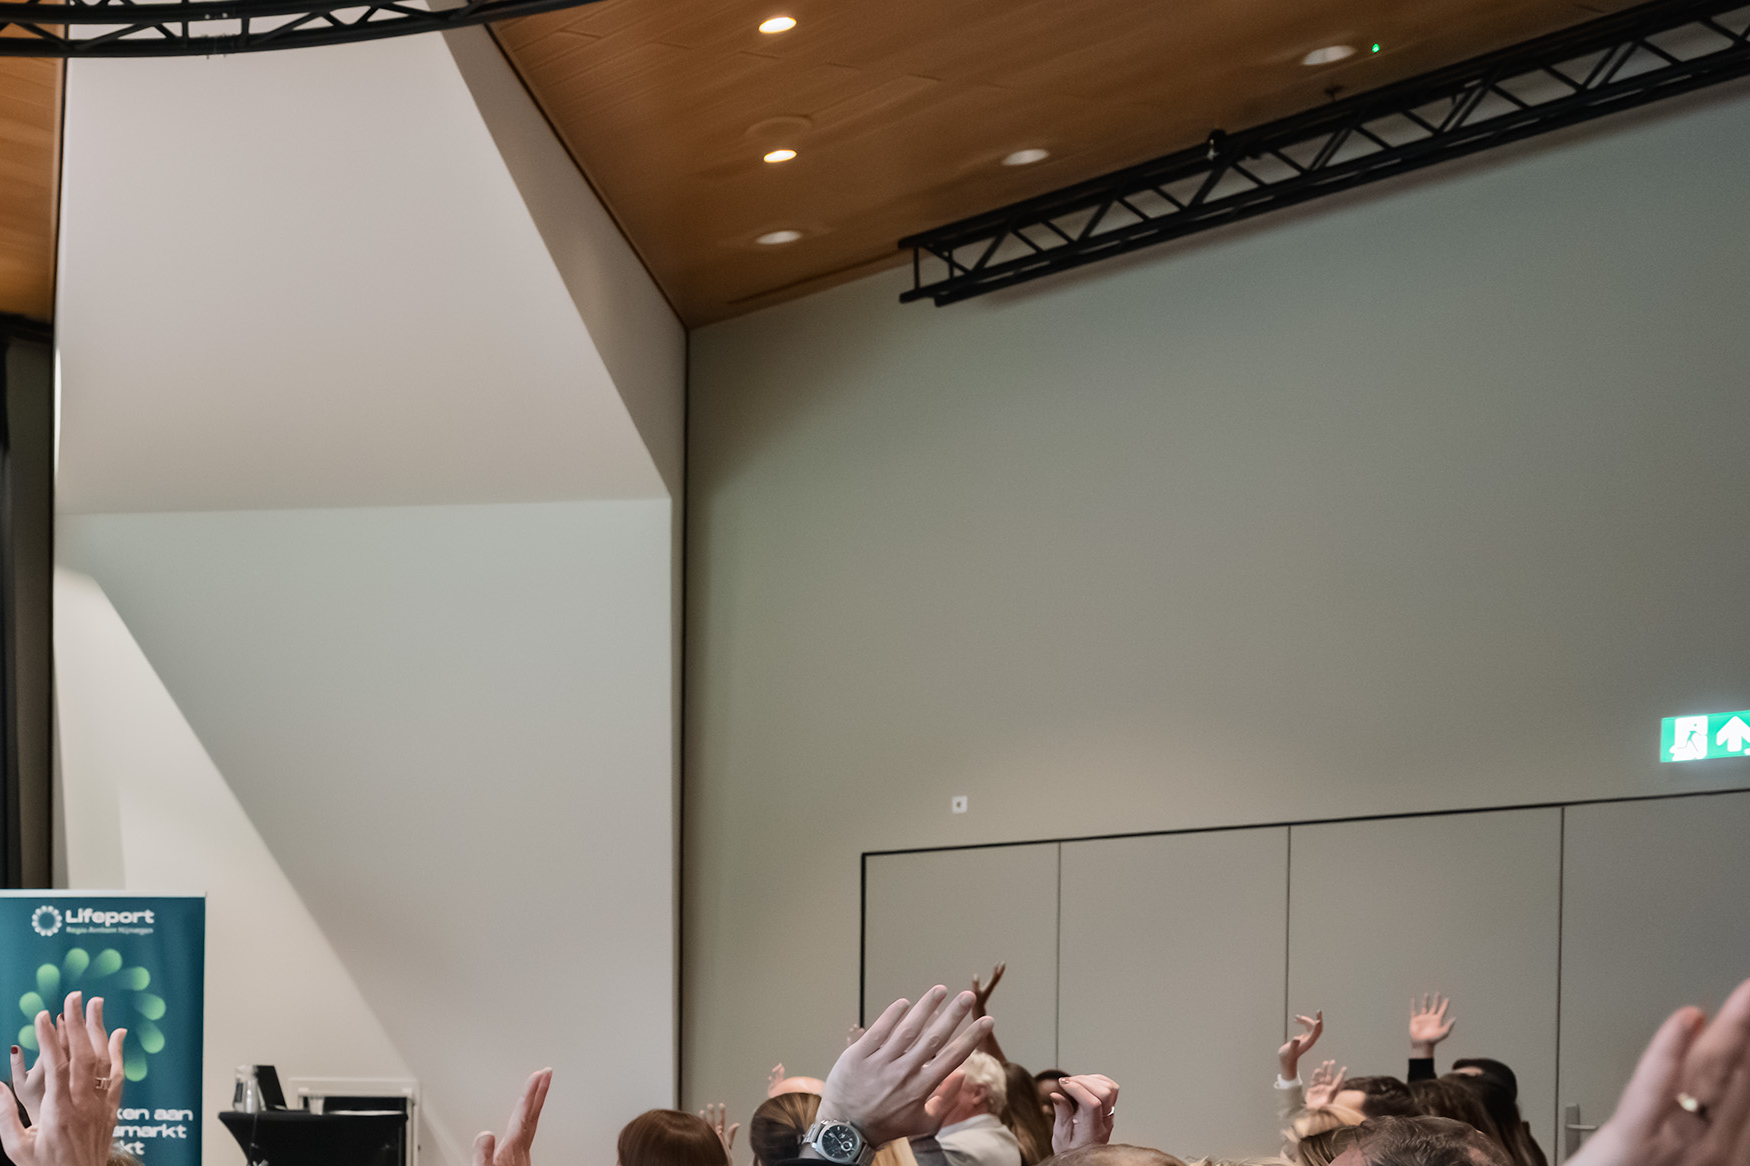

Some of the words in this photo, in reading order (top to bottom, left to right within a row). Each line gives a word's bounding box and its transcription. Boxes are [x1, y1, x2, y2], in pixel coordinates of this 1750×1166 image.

[65, 907, 155, 925] Lifeport
[154, 1108, 194, 1122] aan
[112, 1123, 187, 1139] smarkt
